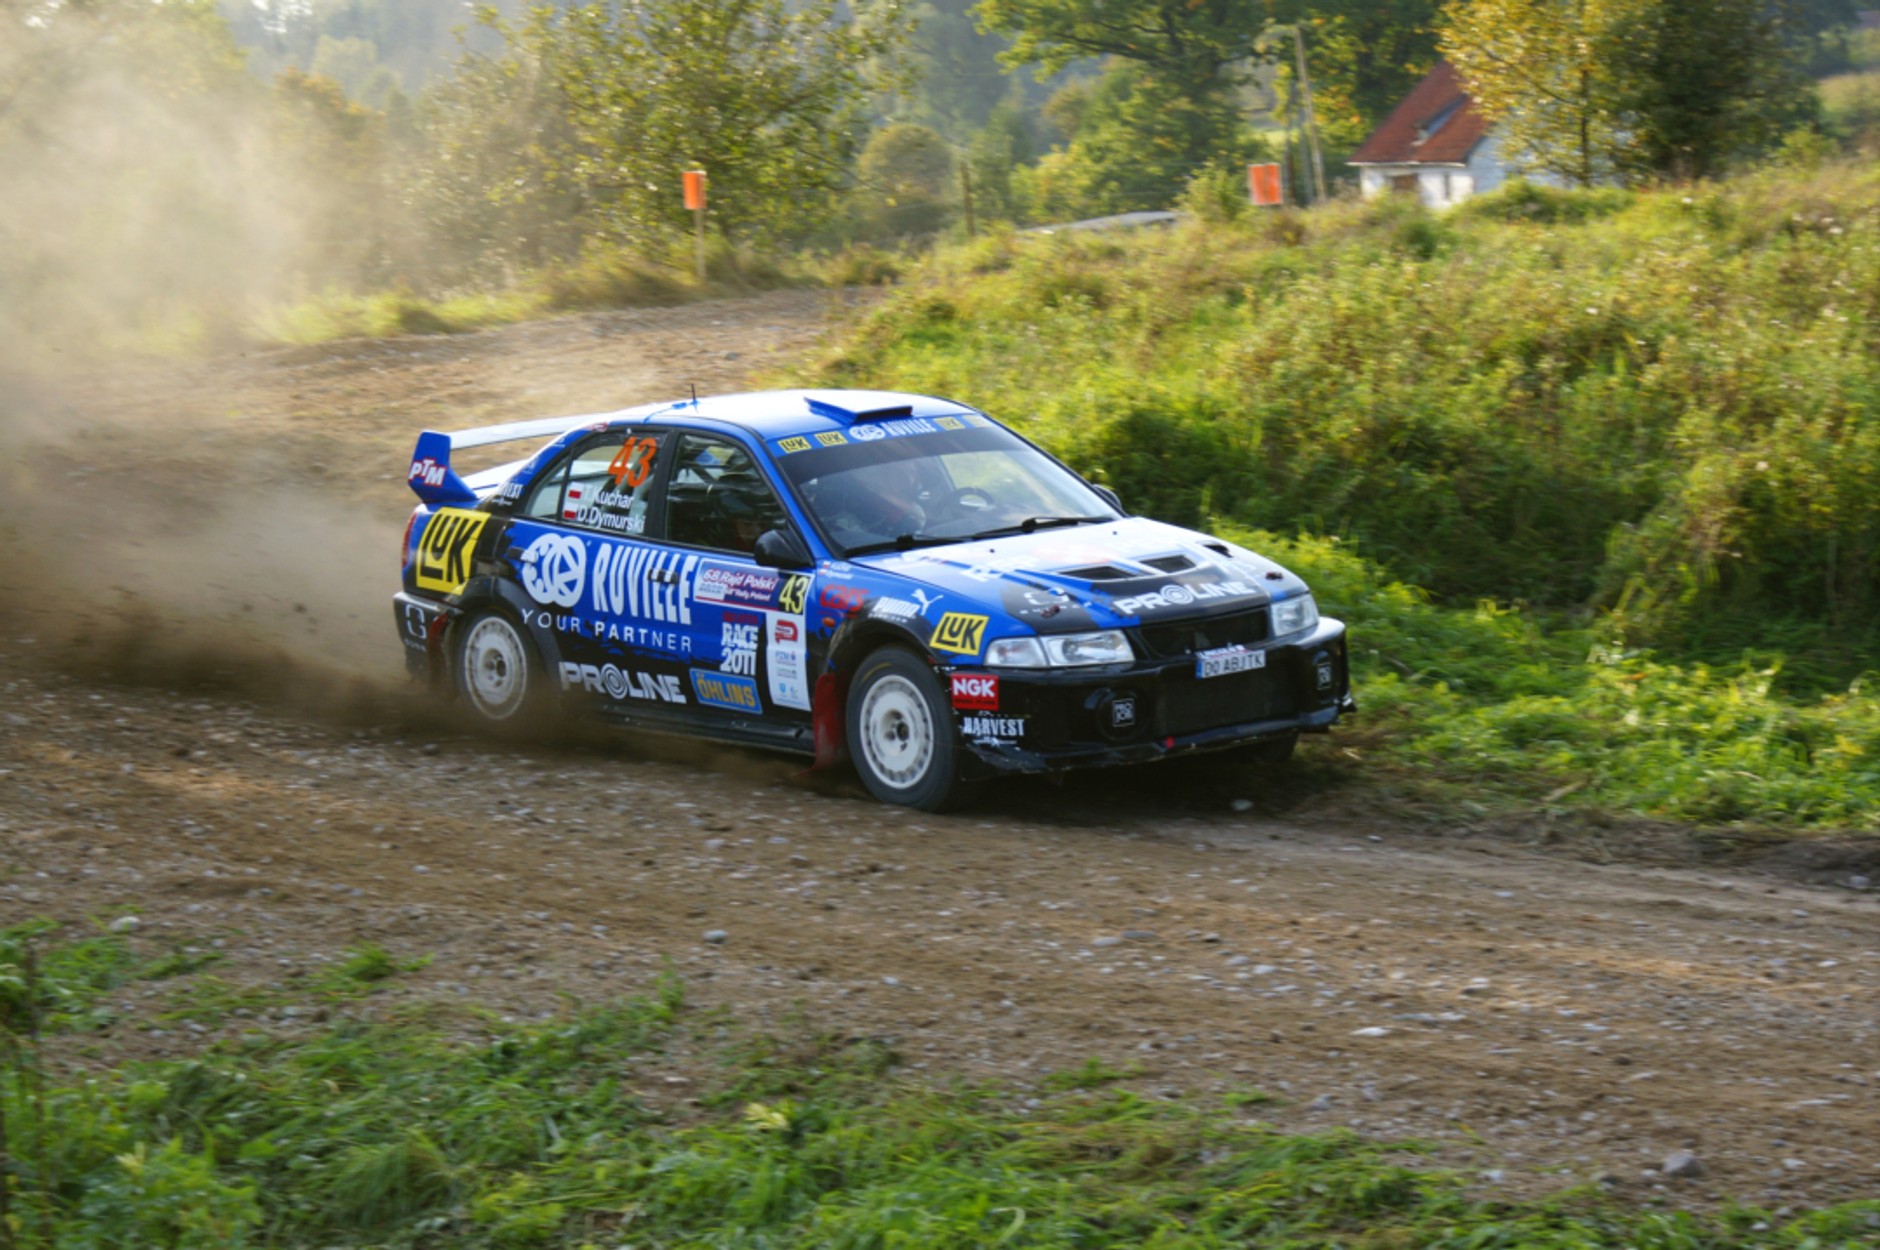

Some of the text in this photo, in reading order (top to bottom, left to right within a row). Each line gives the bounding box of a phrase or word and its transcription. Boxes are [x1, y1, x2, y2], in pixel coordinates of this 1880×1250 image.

[408, 458, 447, 486] PTM
[608, 436, 657, 487] 43
[592, 542, 699, 625] RUVILLE
[703, 568, 780, 591] 68 Rajd Polski
[779, 574, 809, 614] 43
[1112, 581, 1256, 615] PROLINE
[521, 608, 691, 652] YOUR PARTNER
[721, 621, 759, 650] RACE
[720, 647, 757, 676] 2011
[559, 661, 687, 704] PROLINE
[952, 678, 996, 698] NGK
[962, 716, 1025, 737] HARVEST
